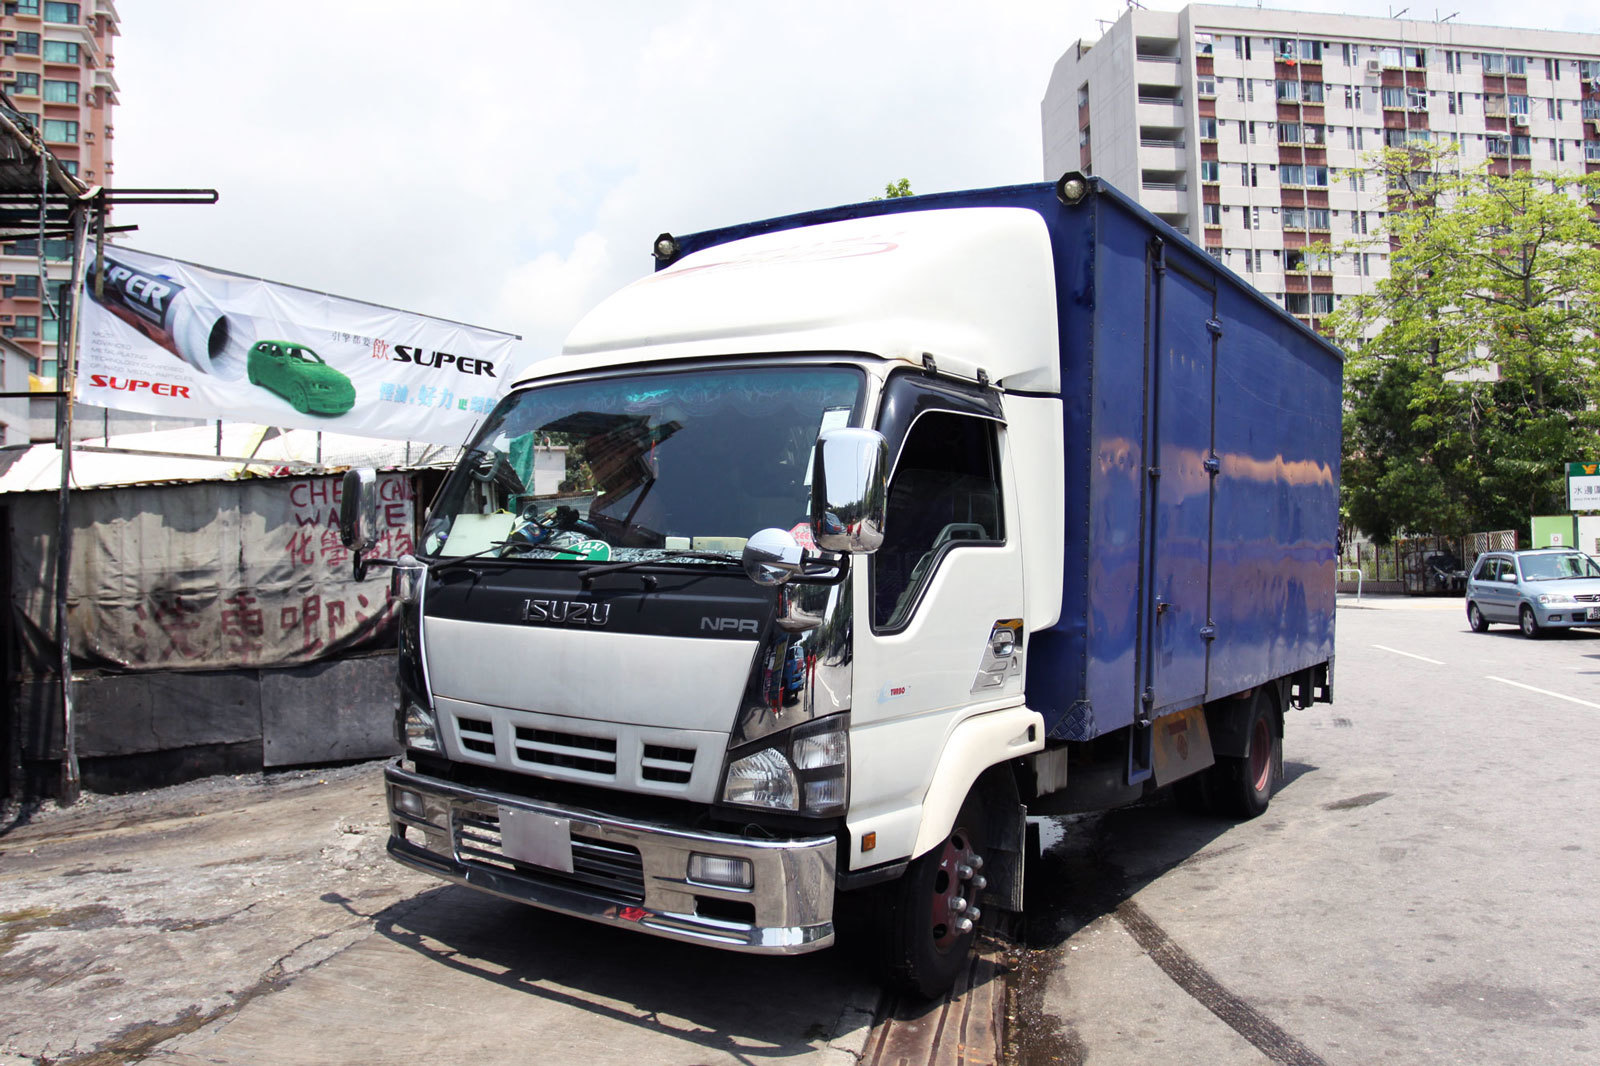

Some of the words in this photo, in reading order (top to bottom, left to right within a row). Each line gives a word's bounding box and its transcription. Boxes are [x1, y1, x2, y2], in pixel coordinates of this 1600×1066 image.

[393, 345, 497, 377] SUPER
[89, 374, 190, 399] SUPER
[290, 475, 414, 508] CHECAL
[295, 503, 406, 529] WAE
[577, 542, 605, 552] TAXI
[521, 599, 611, 626] ISUZU
[700, 616, 760, 634] NPR
